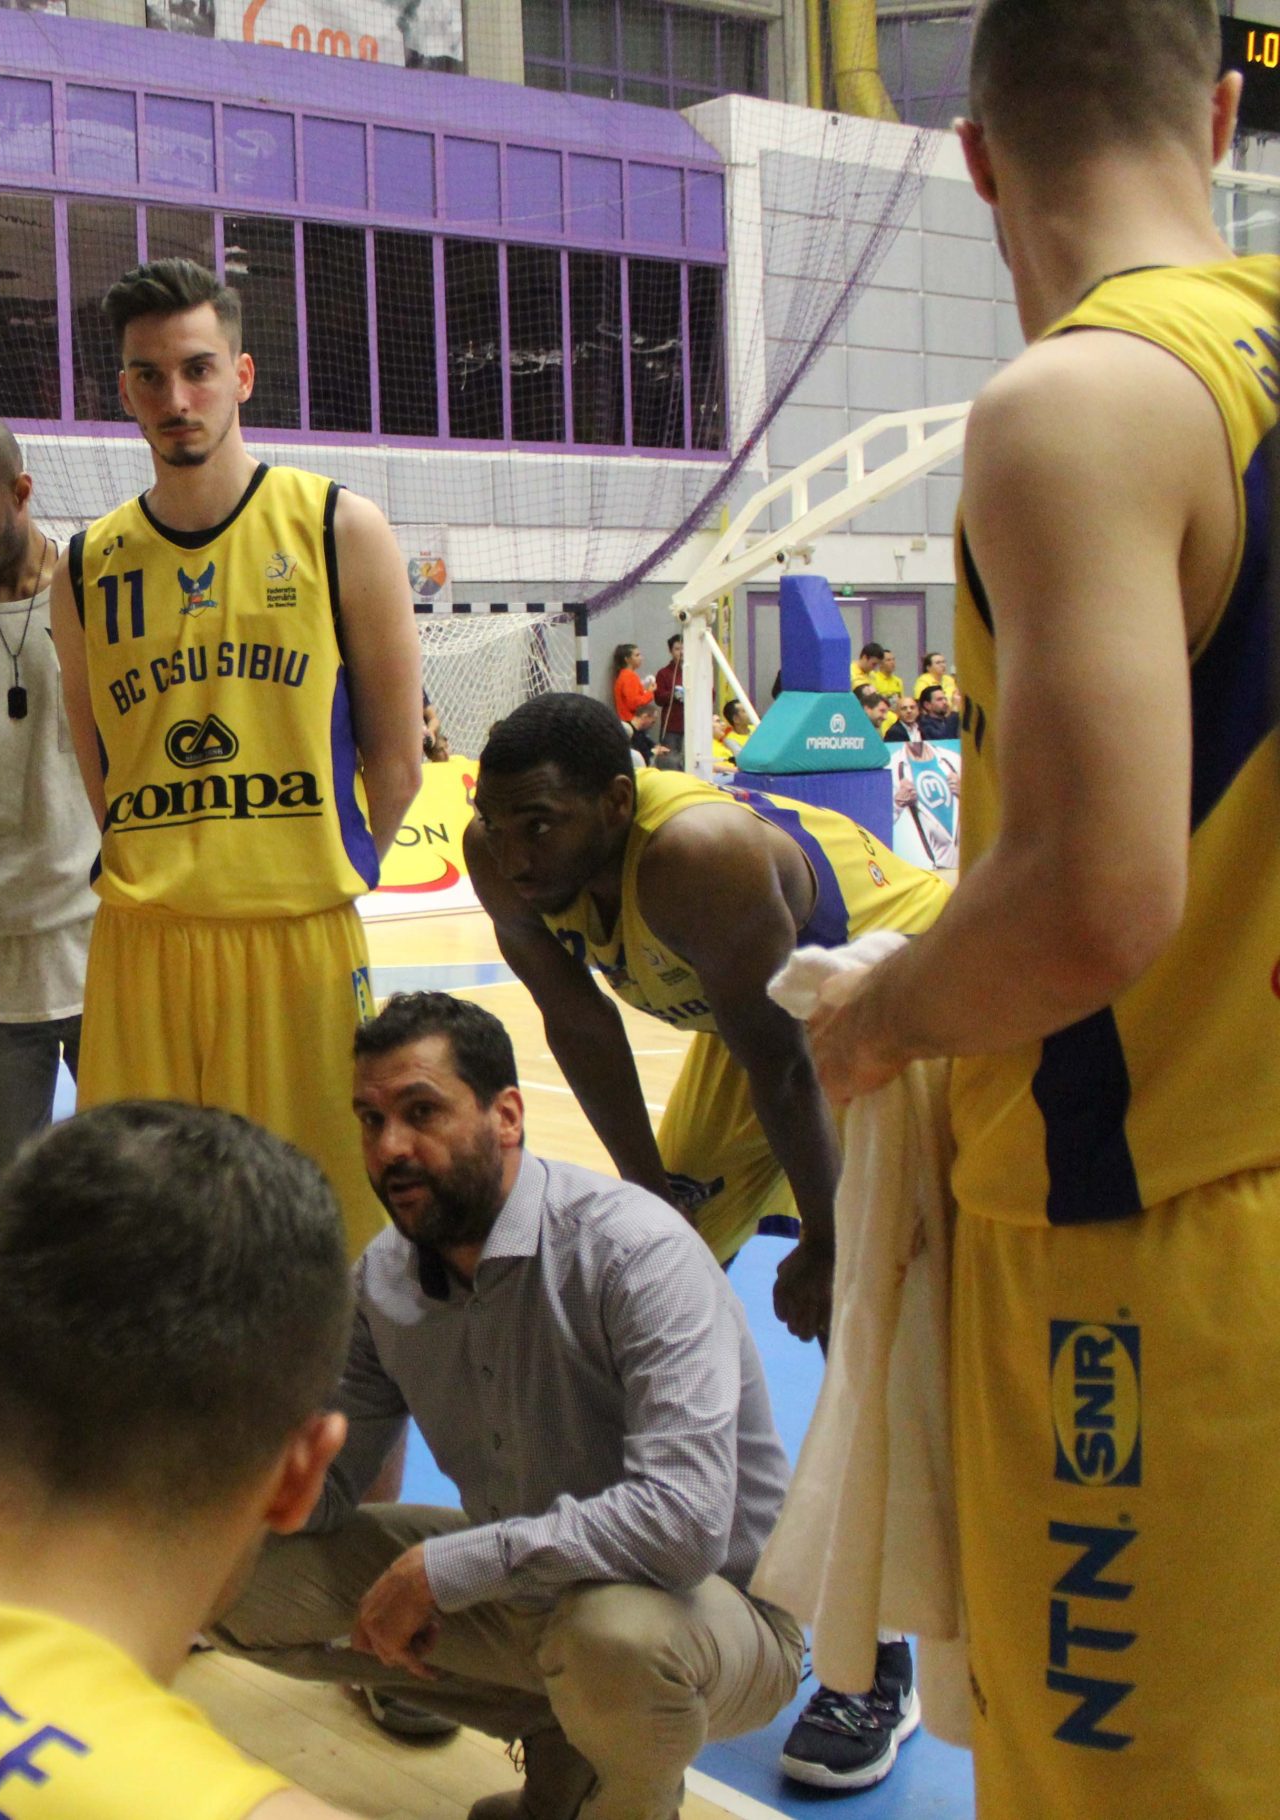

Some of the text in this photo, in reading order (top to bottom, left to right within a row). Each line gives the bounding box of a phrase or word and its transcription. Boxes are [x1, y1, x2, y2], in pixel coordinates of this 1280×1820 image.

[97, 568, 146, 645] 11
[108, 641, 311, 716] BC CSU SIBIU
[805, 736, 865, 750] MARQUARDT
[110, 769, 325, 826] compa
[1073, 1332, 1117, 1482] SNR
[1045, 1519, 1141, 1752] NTN
